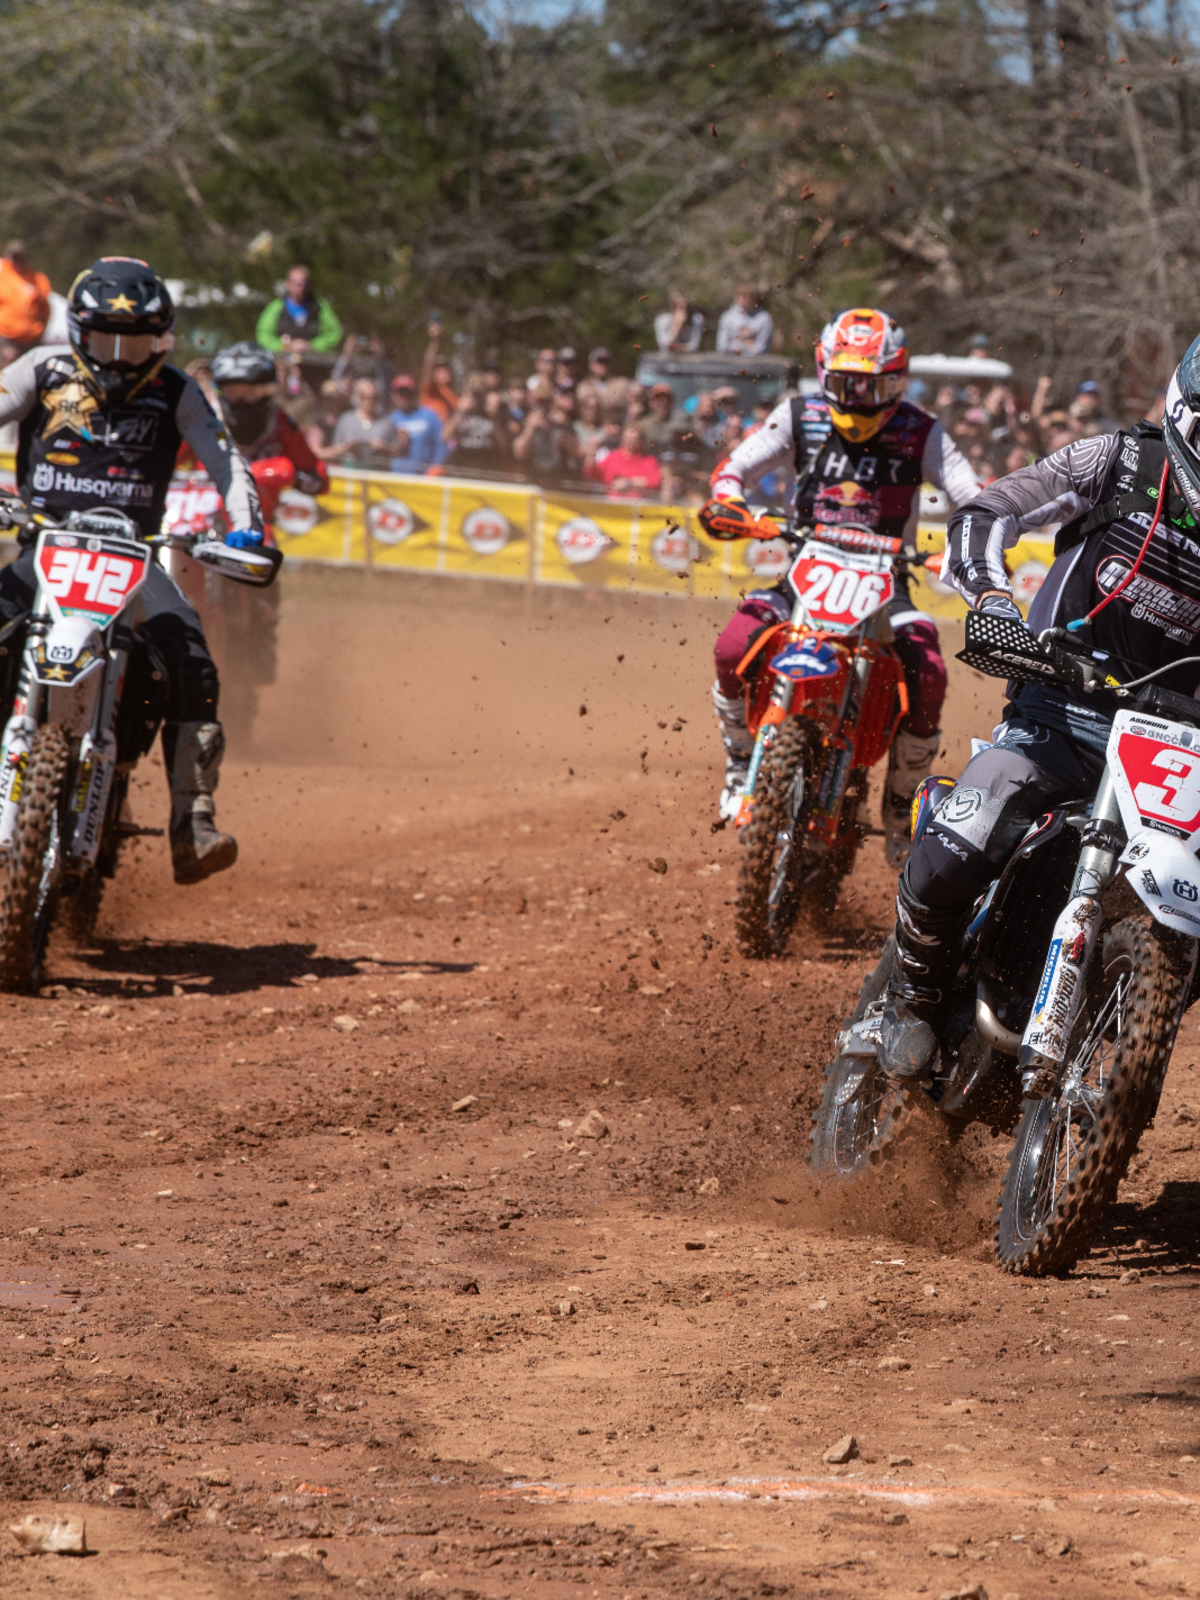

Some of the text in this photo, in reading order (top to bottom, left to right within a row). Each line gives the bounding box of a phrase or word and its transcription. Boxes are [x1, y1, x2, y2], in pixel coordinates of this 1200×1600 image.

[55, 472, 154, 498] Husqvarna
[813, 502, 846, 523] Red
[48, 549, 134, 607] 342
[802, 564, 886, 620] 206
[1143, 609, 1194, 641] Husqvarna
[1038, 944, 1058, 1004] MICHELIN
